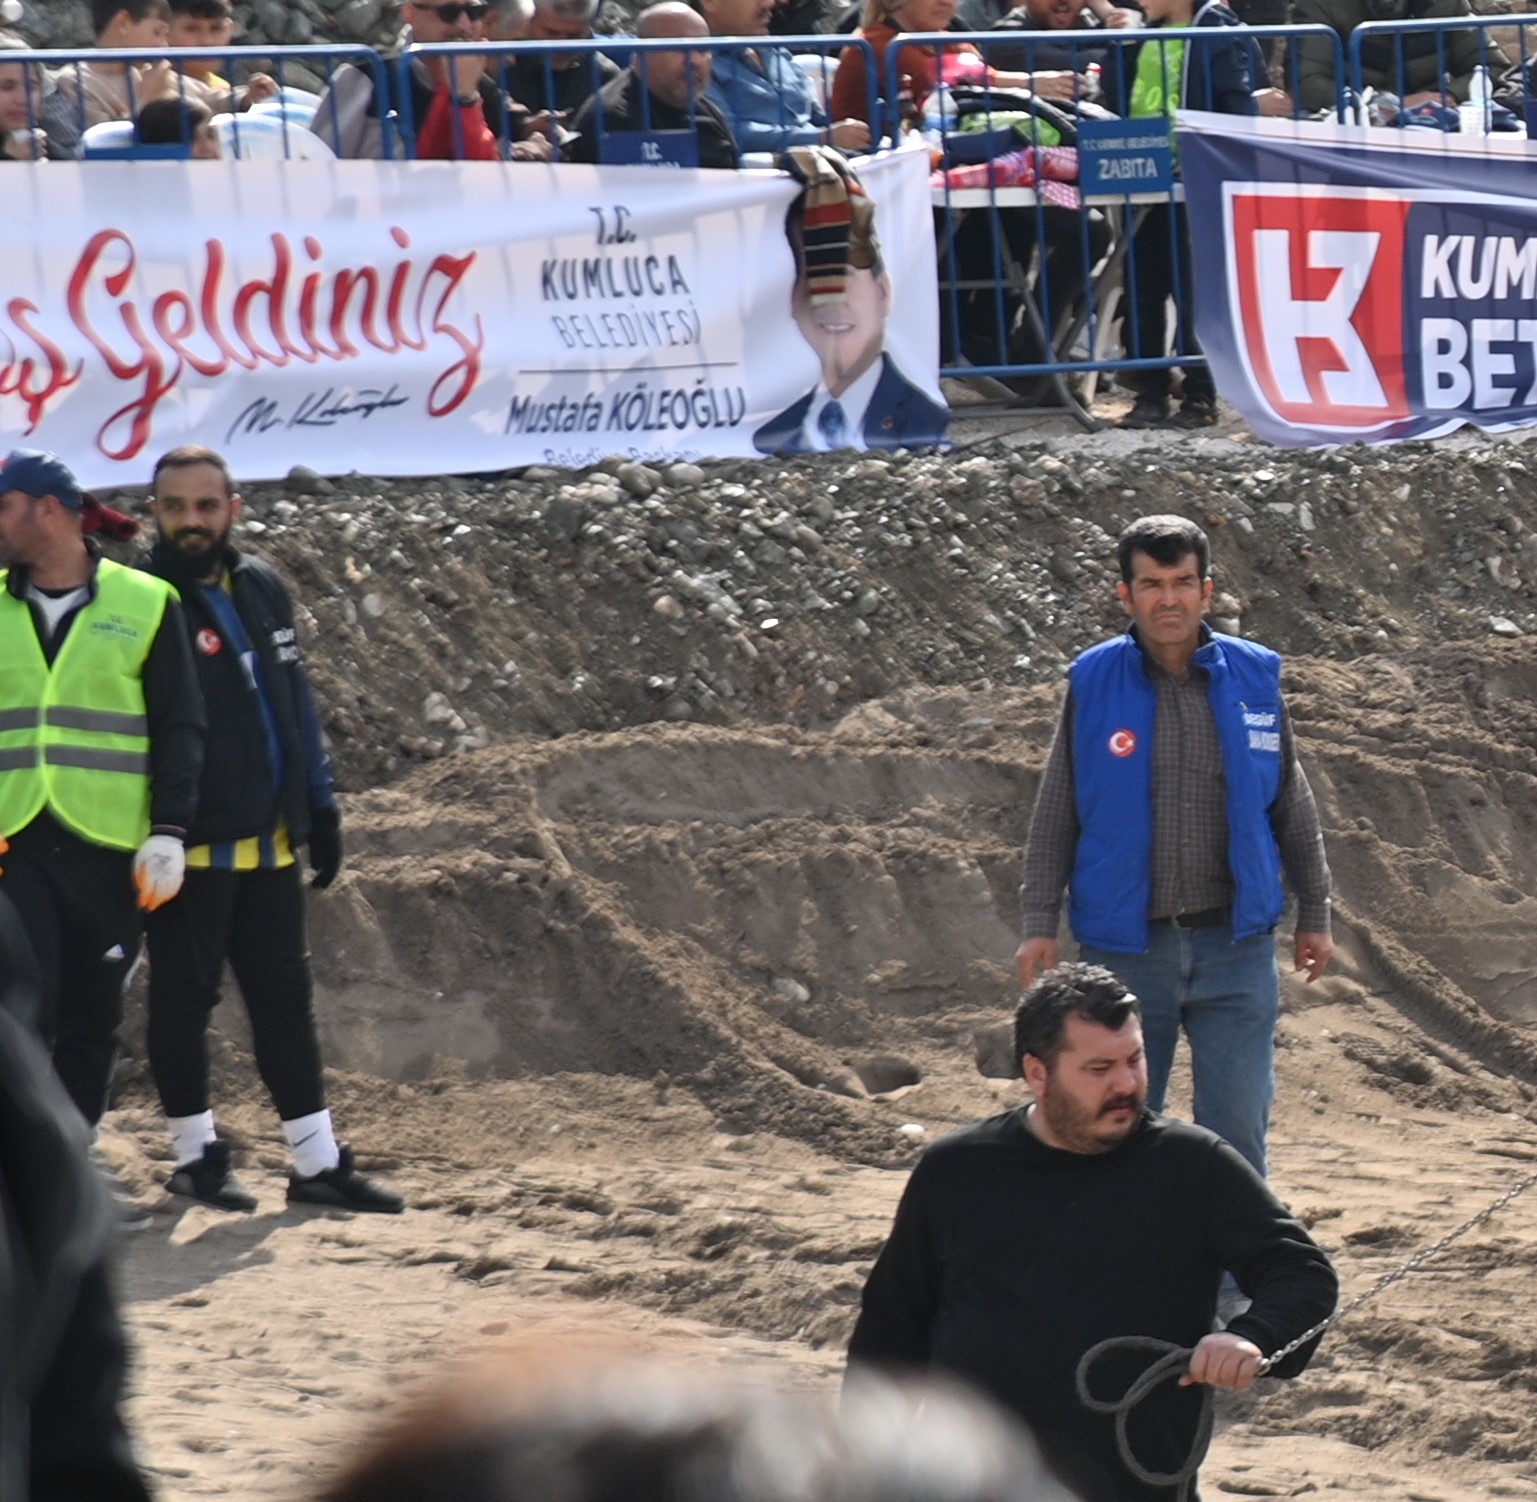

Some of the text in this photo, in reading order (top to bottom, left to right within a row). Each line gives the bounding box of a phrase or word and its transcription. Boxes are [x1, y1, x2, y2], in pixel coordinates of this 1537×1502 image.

[1098, 157, 1159, 180] ZABITA
[588, 204, 638, 245] T.C.
[541, 254, 691, 301] KUMLUCA
[66, 225, 485, 461] Geldiniz
[551, 299, 701, 350] BELEDİYESİ
[504, 378, 748, 435] Mustafa KÖLEOĞLU
